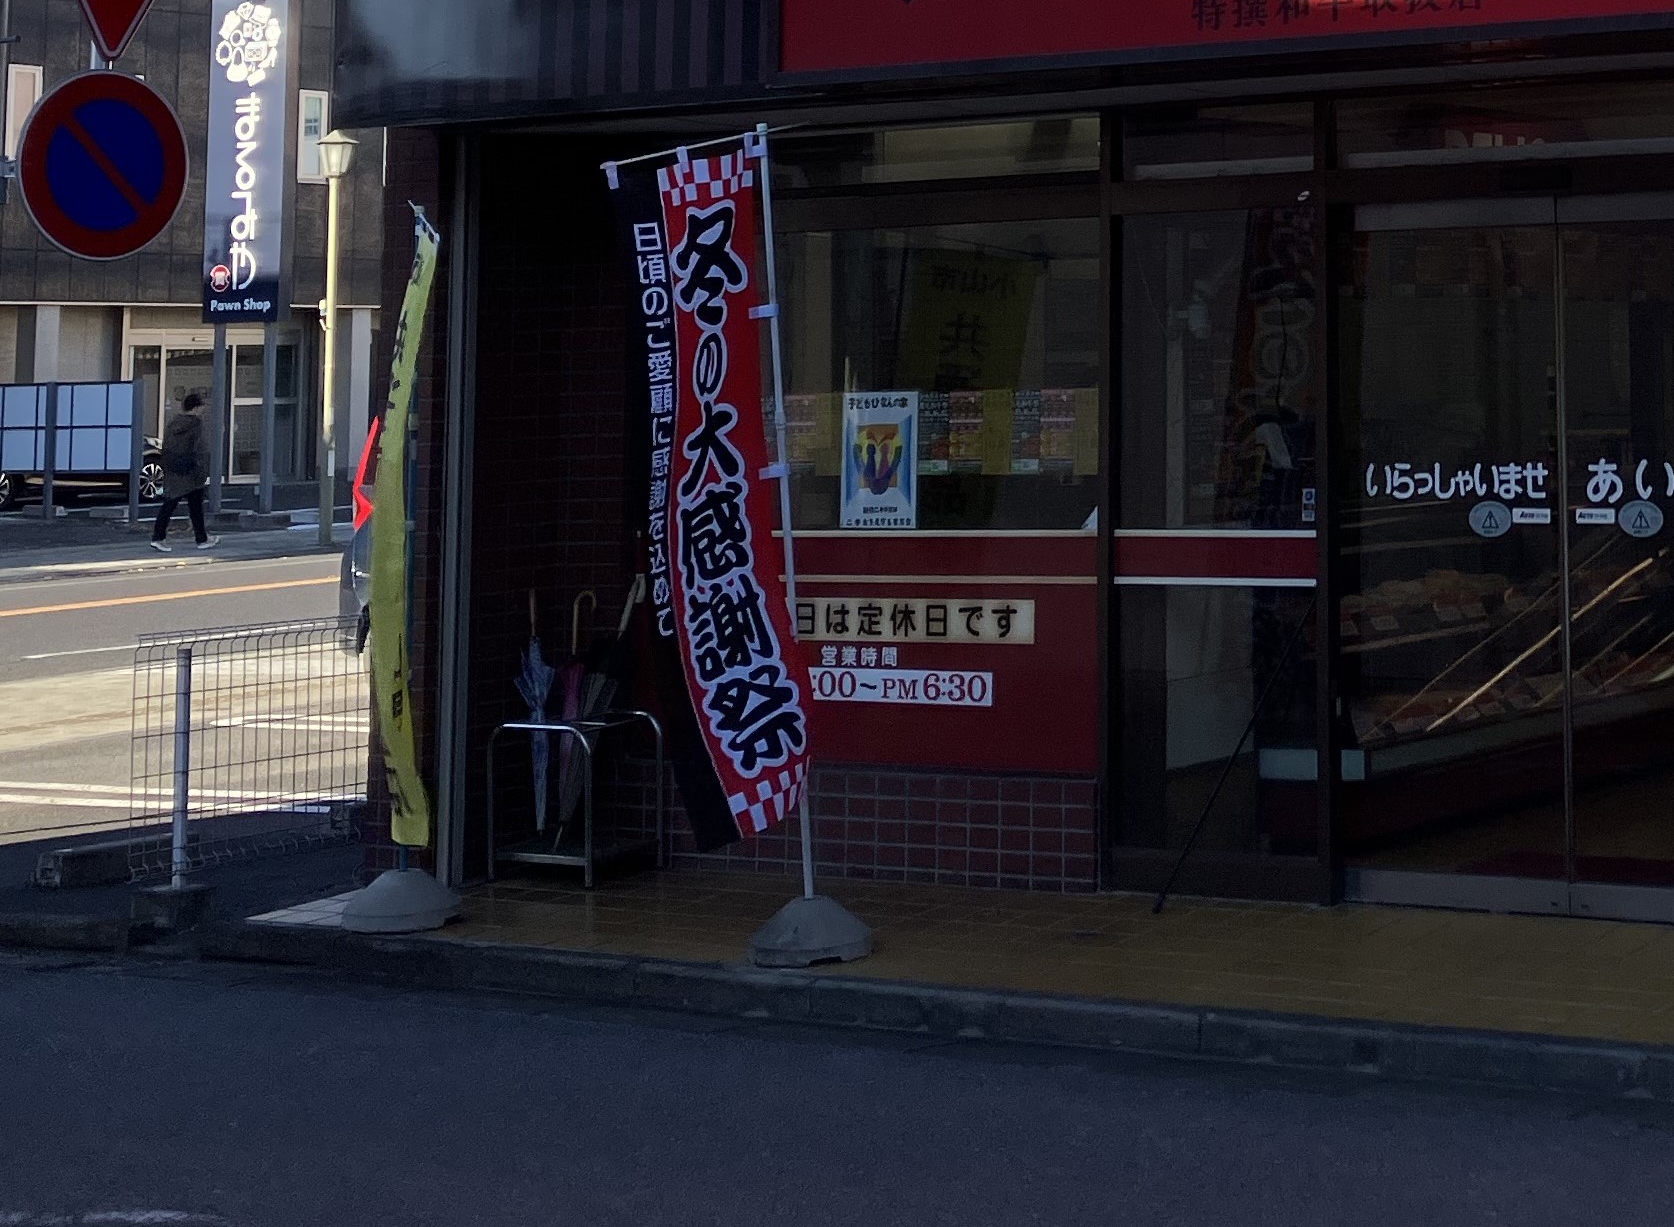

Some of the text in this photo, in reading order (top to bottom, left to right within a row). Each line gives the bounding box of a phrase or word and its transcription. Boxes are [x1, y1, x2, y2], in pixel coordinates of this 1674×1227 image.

[210, 297, 271, 313] Pawn Shop
[633, 222, 677, 637] 日頃のご愛顧に感謝を込めて
[675, 201, 802, 776] 冬の大感謝祭
[1365, 461, 1548, 500] いらっしゃいませ
[796, 603, 1018, 638] 日は定休日です
[820, 645, 898, 668] 営業時間
